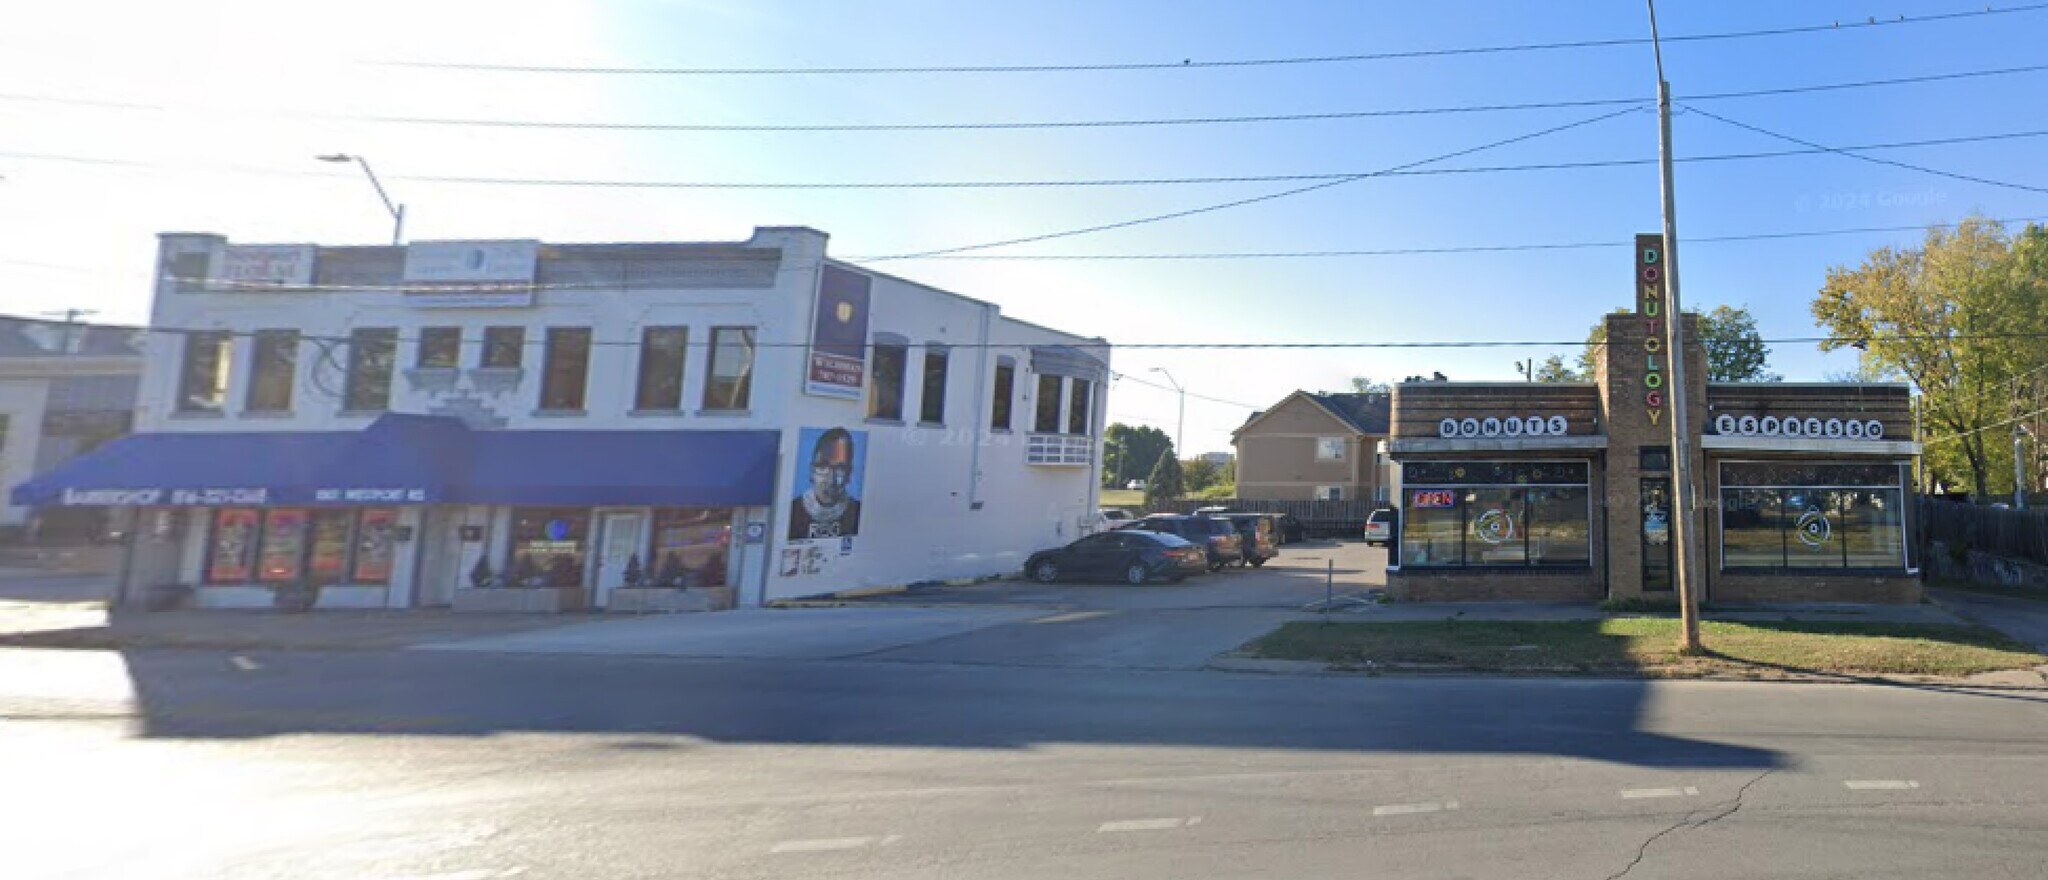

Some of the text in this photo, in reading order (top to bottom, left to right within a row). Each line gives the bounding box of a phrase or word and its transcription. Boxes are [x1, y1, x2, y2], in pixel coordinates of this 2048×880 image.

[1643, 248, 1662, 426] DONUTOLOGY
[1441, 416, 1566, 438] DONUTS
[1718, 416, 1882, 438] ESPRESSO
[1414, 491, 1451, 506] OPEN
